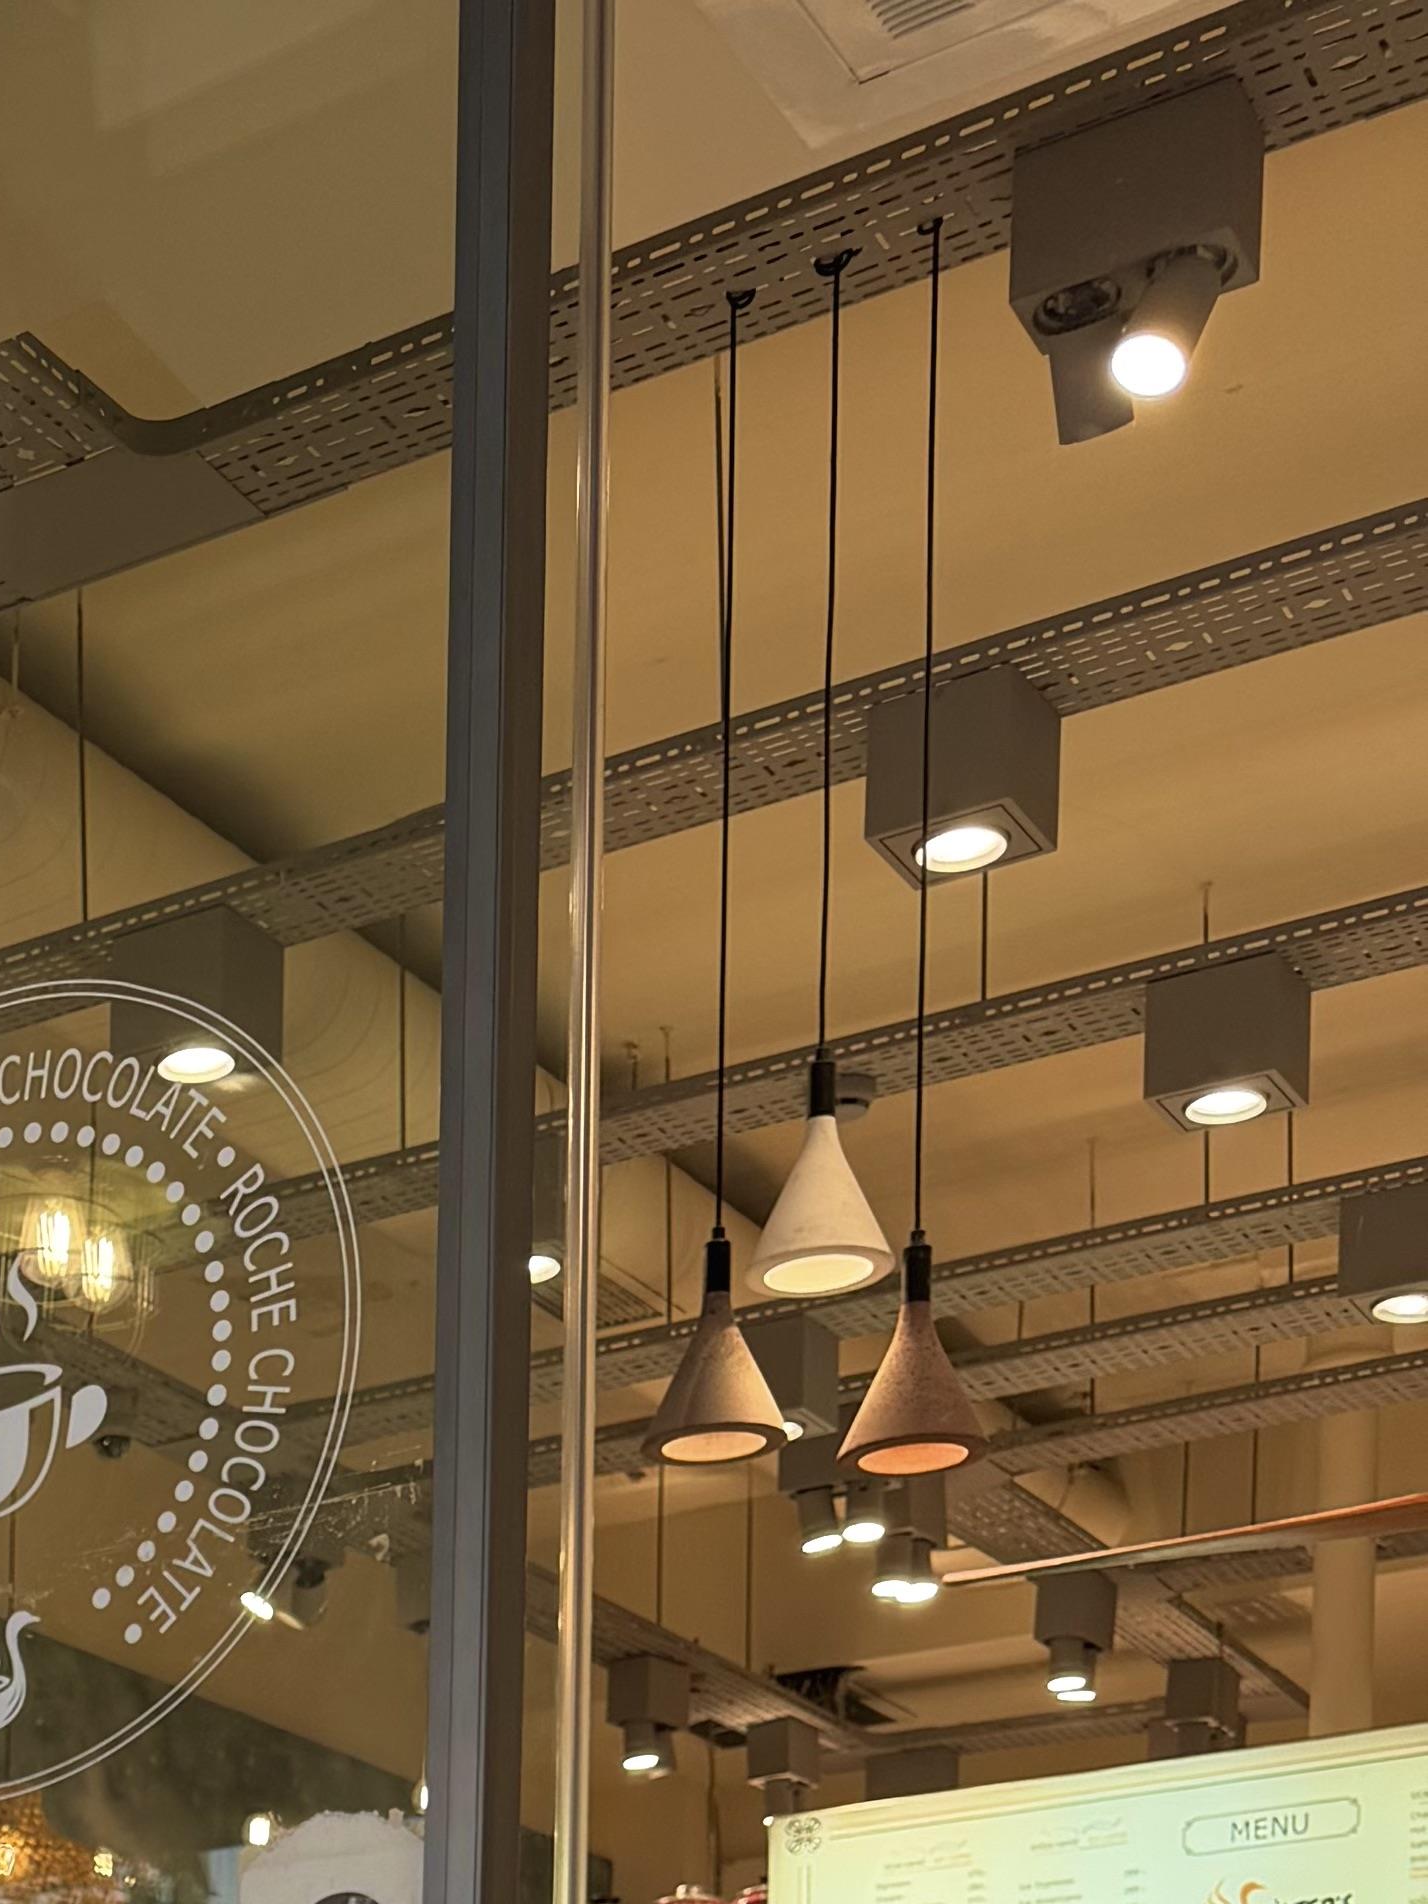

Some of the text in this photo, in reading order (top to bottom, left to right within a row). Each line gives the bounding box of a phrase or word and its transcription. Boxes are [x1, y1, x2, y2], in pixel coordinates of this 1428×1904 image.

[137, 1163, 297, 1634] ROCHE CHOCOLATE
[1230, 1811, 1310, 1844] MENU
